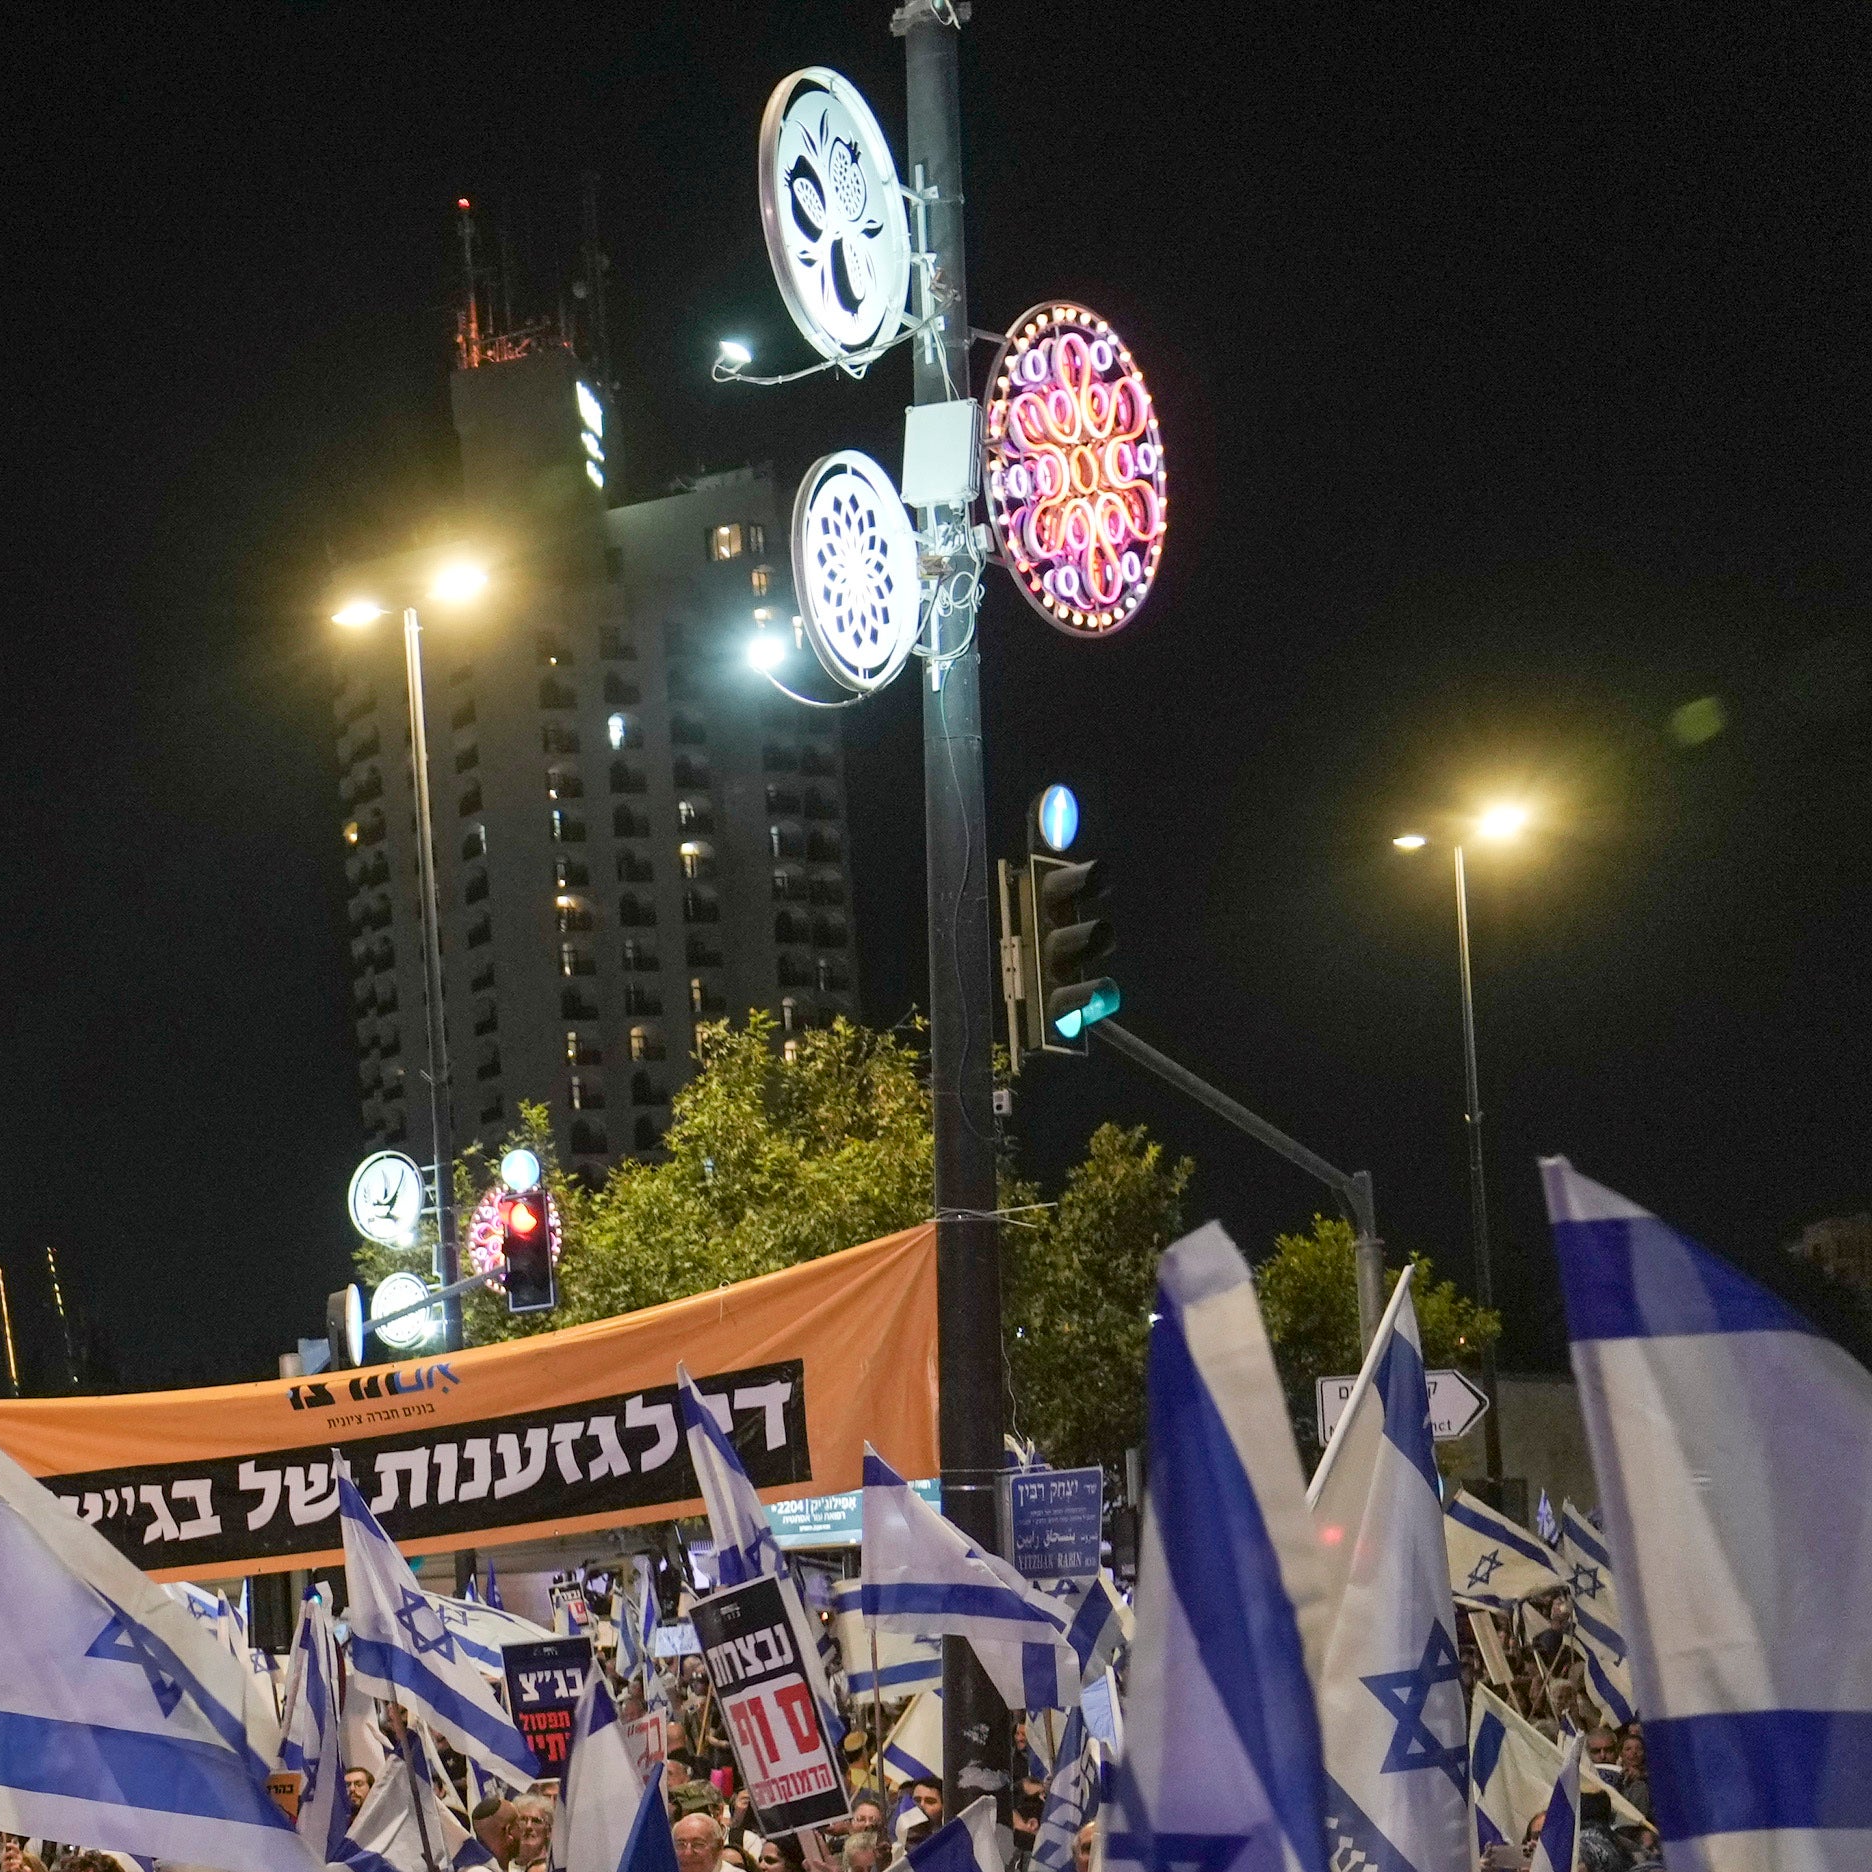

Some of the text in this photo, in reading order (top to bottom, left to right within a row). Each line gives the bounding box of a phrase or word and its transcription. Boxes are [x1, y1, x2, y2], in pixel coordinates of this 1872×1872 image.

[327, 1402, 436, 1430] בונים חברה ציונית
[370, 1394, 679, 1516] לגזענות
[238, 1458, 352, 1532] של
[706, 1622, 794, 1688] נבצרות
